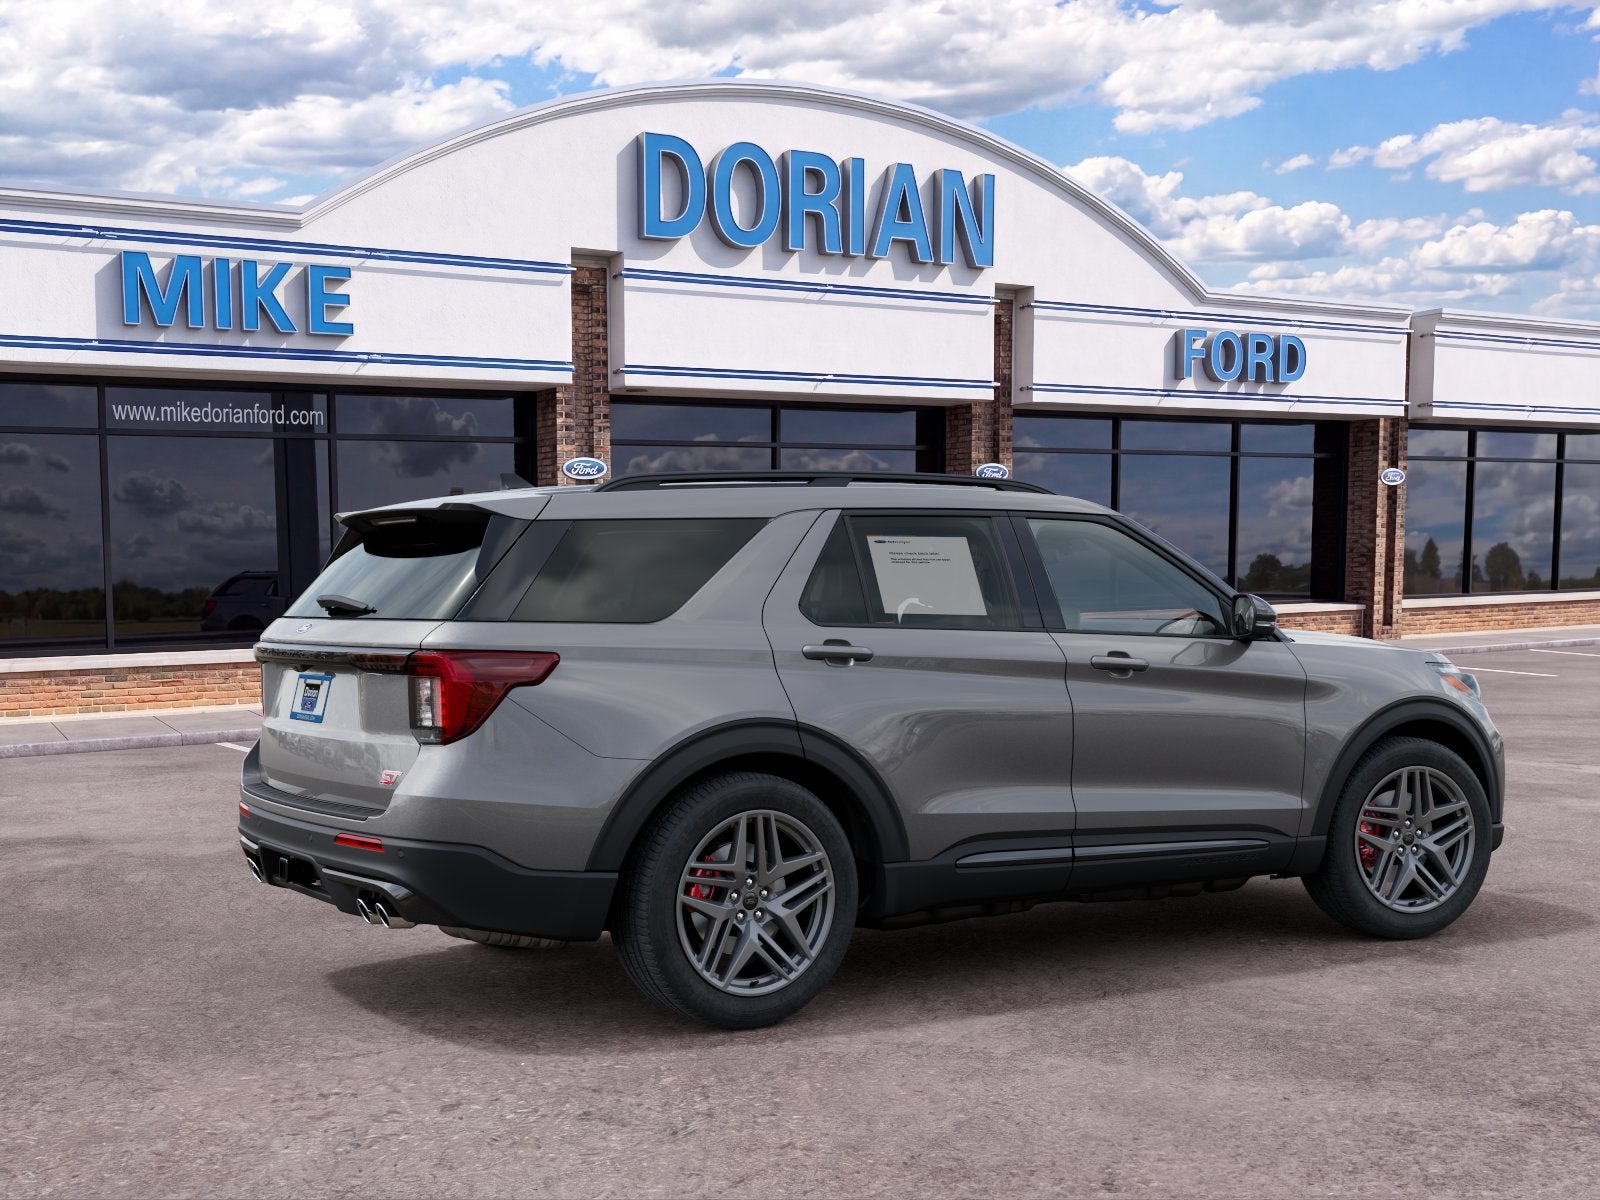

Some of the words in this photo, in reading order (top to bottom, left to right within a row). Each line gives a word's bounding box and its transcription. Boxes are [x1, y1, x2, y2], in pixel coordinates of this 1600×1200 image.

[638, 131, 995, 268] DORIAN
[121, 250, 354, 335] MIKE
[1178, 328, 1306, 383] FORD
[112, 401, 324, 426] www.mikedorianford.com
[379, 770, 403, 785] ST
